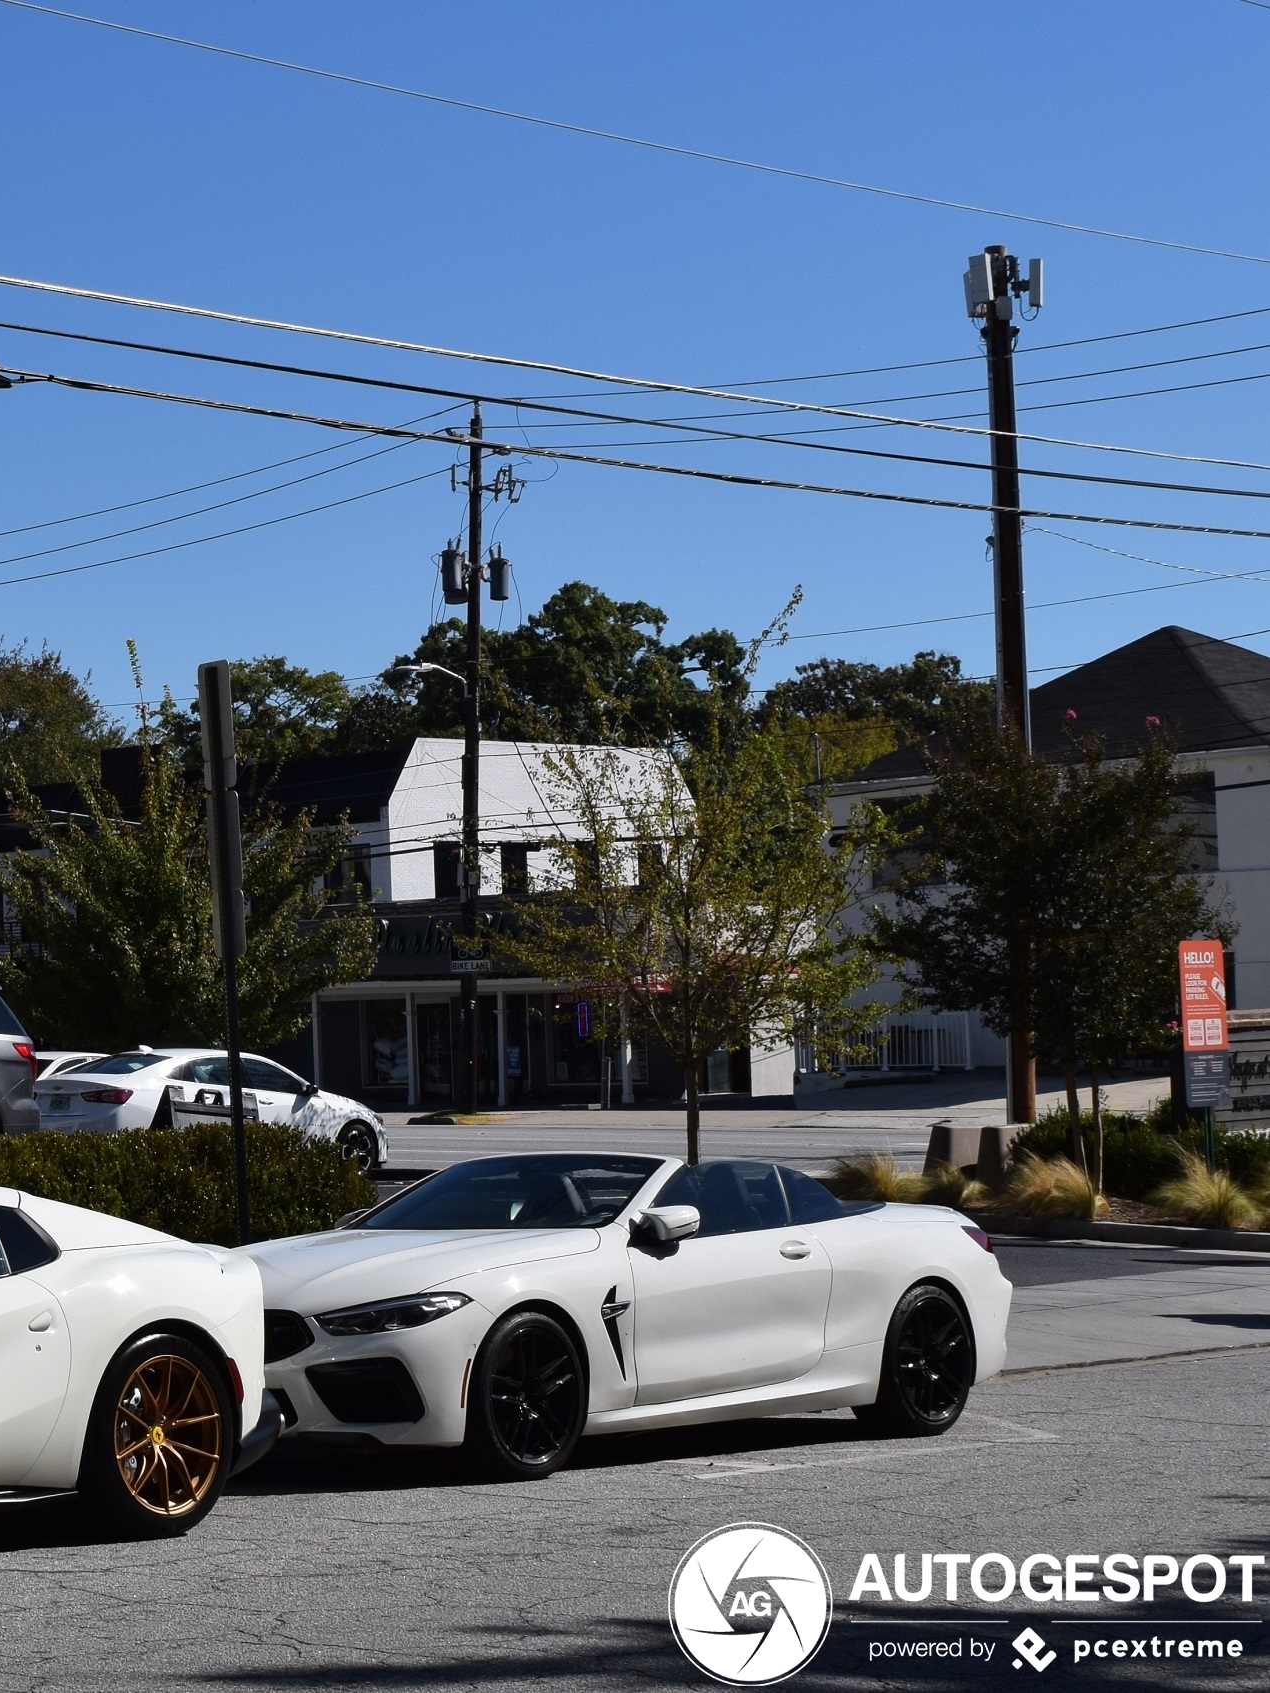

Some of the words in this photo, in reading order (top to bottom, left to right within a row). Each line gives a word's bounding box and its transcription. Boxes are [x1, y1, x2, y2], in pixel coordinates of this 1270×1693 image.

[1183, 951, 1214, 964] HELLO!
[452, 962, 469, 970] BIKE
[470, 961, 490, 970] LANE
